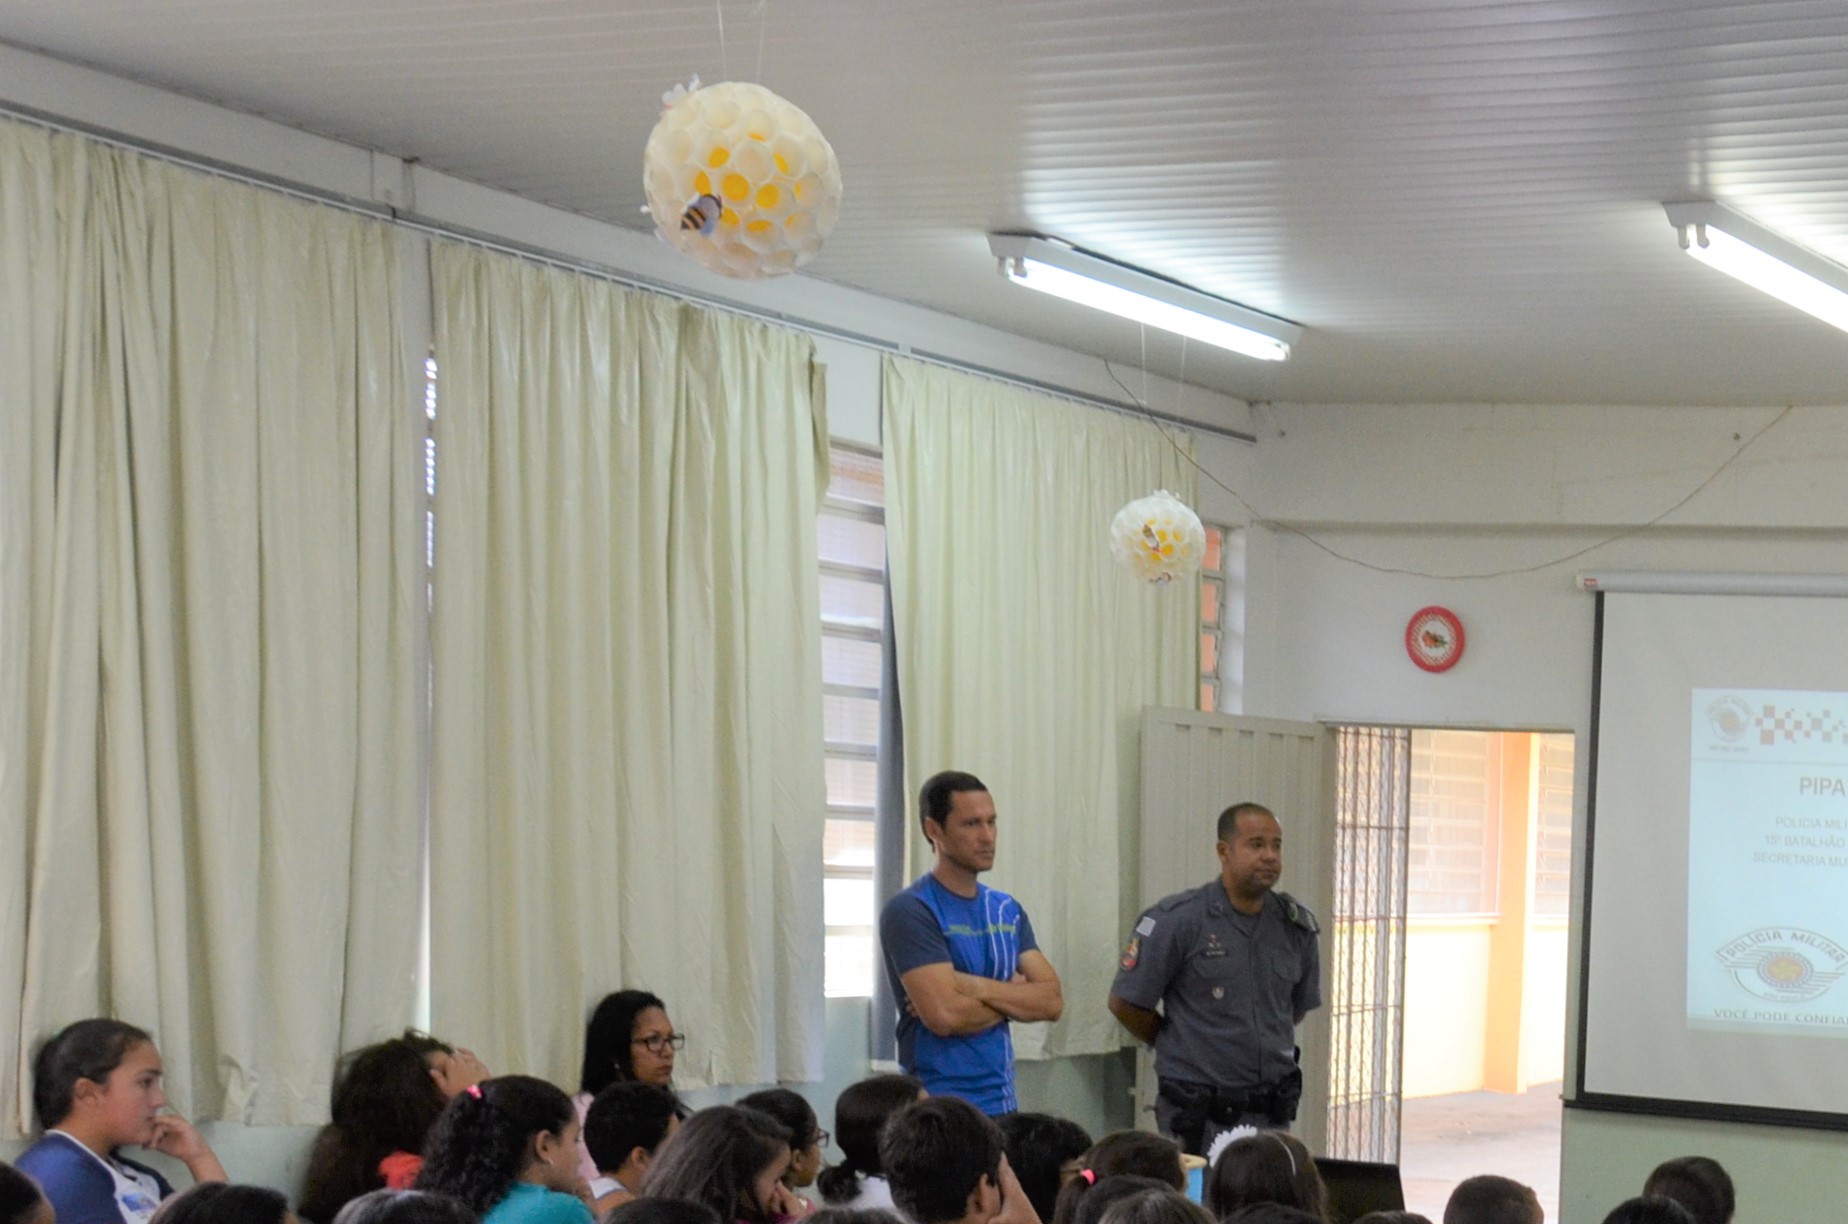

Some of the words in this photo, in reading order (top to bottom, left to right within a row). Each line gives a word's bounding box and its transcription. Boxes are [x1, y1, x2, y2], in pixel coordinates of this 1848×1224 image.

[1799, 777, 1846, 796] PIPA
[1784, 835, 1845, 849] BATALHÃO
[1752, 852, 1826, 866] SECRETARIA
[1726, 930, 1784, 958] POLÍCIA
[1790, 931, 1846, 963] MILITAR
[1754, 1010, 1788, 1022] PODE
